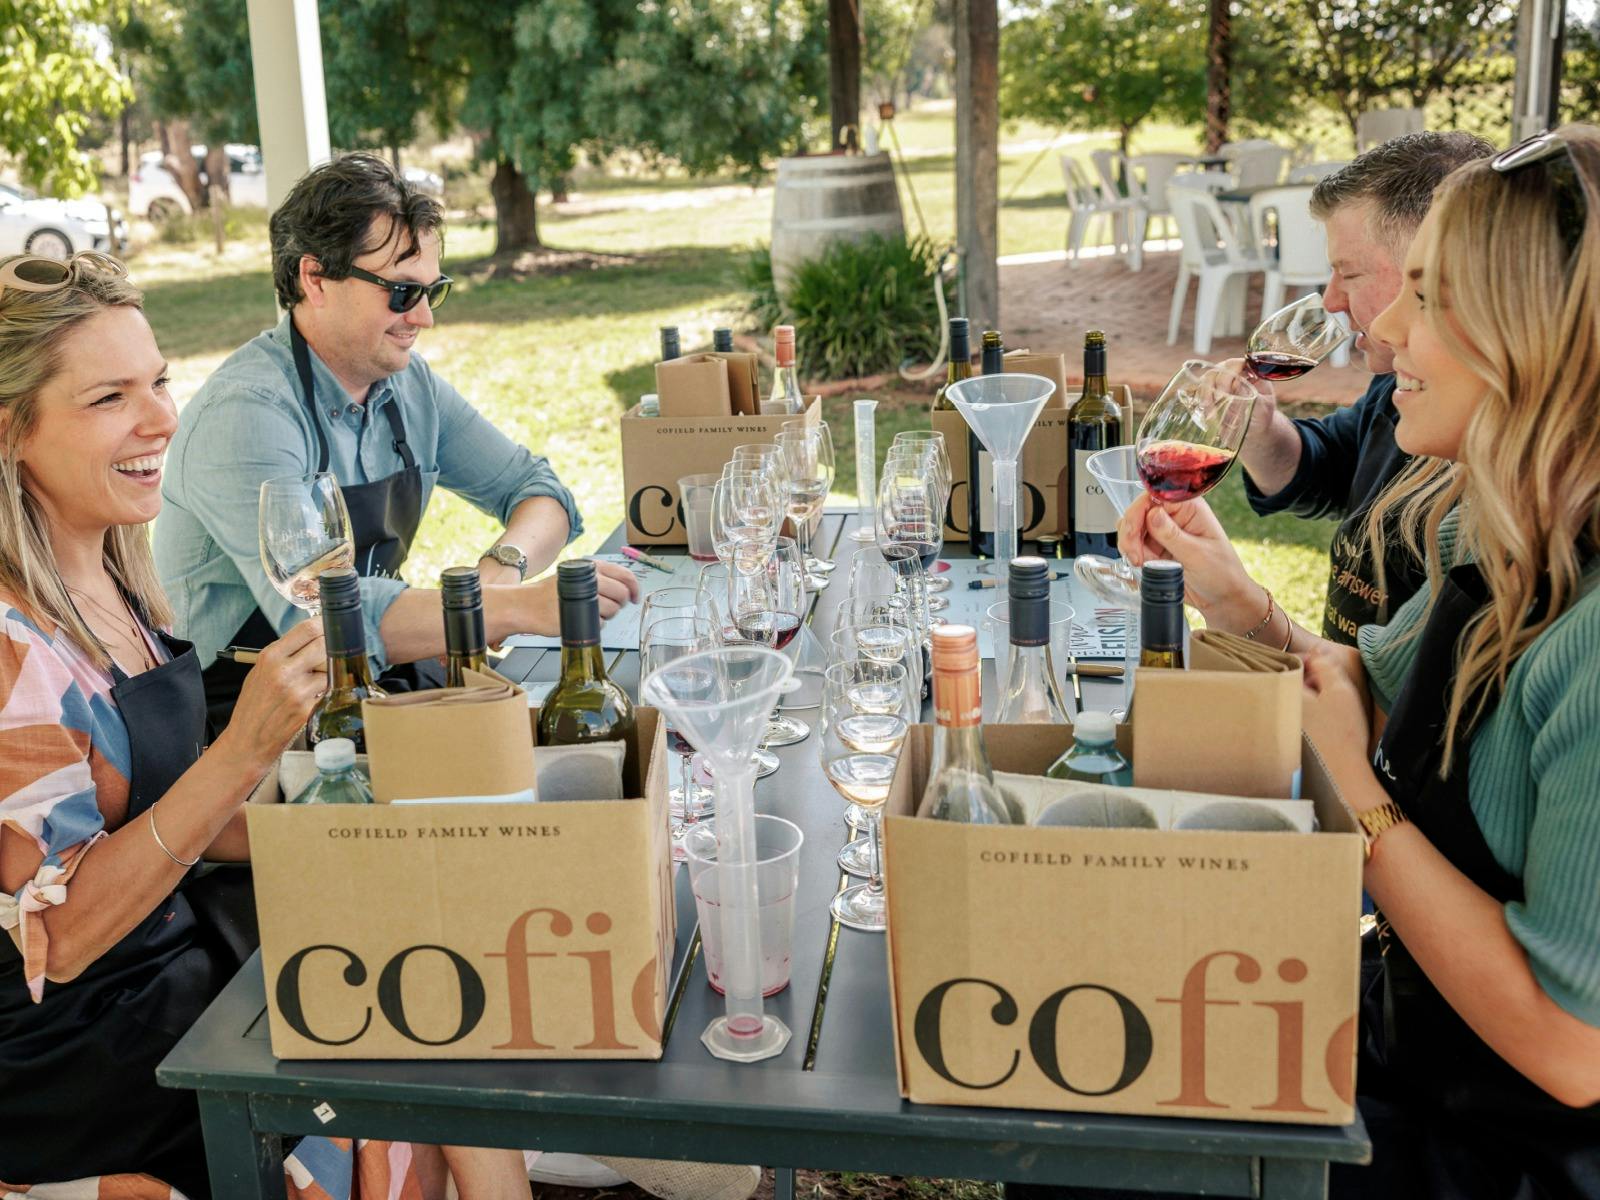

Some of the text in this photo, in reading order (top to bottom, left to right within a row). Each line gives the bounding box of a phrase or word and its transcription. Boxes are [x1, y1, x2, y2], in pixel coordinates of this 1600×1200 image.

[328, 825, 562, 839] COFIELD FAMILY WINES
[980, 850, 1250, 872] COFIELD FAMILY WINES
